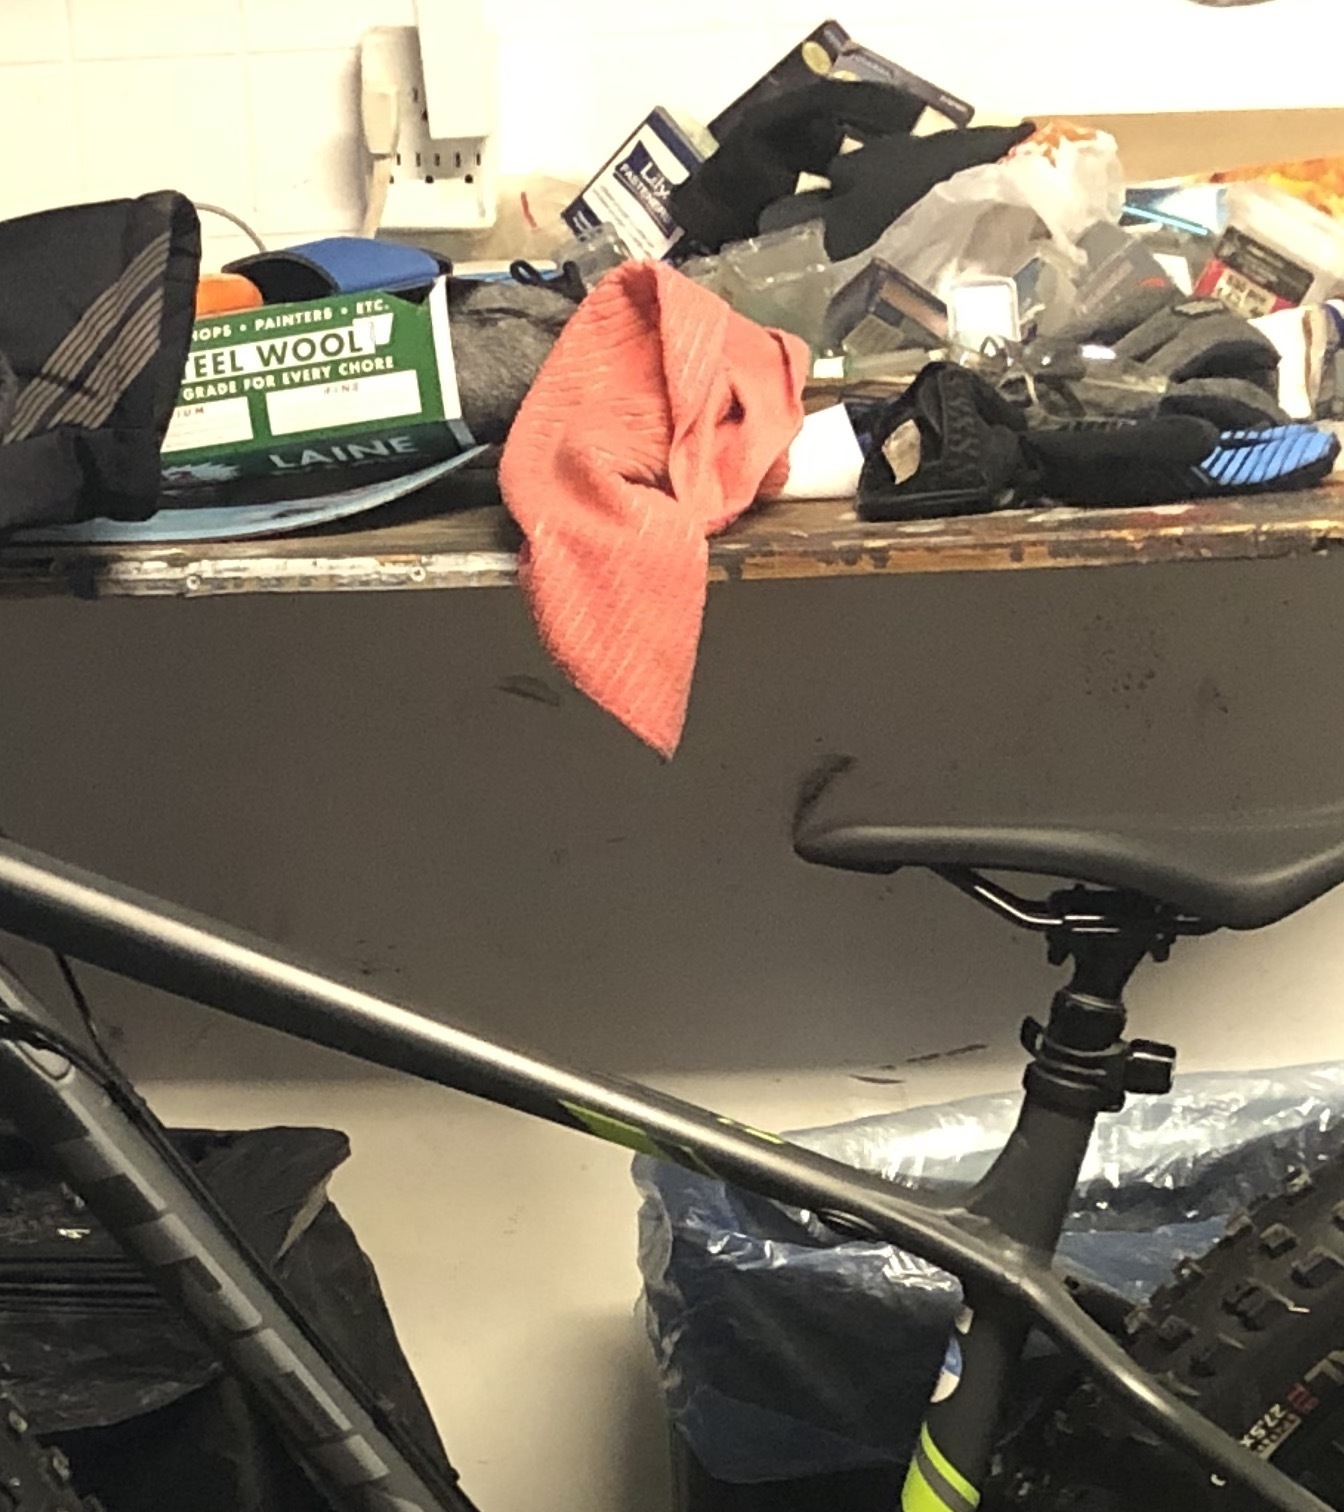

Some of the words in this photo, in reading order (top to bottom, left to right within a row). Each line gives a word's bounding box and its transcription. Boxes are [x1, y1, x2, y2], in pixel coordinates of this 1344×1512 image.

[255, 307, 333, 332] PAINTERS
[356, 299, 390, 315] ETC.
[193, 350, 244, 379] EEL
[256, 330, 363, 367] WOOL
[183, 383, 237, 401] GRADE
[244, 374, 276, 391] FOR
[282, 364, 331, 385] EVERY
[338, 356, 394, 375] CHORE
[177, 406, 205, 418] IUM
[269, 436, 418, 468] LAINE
